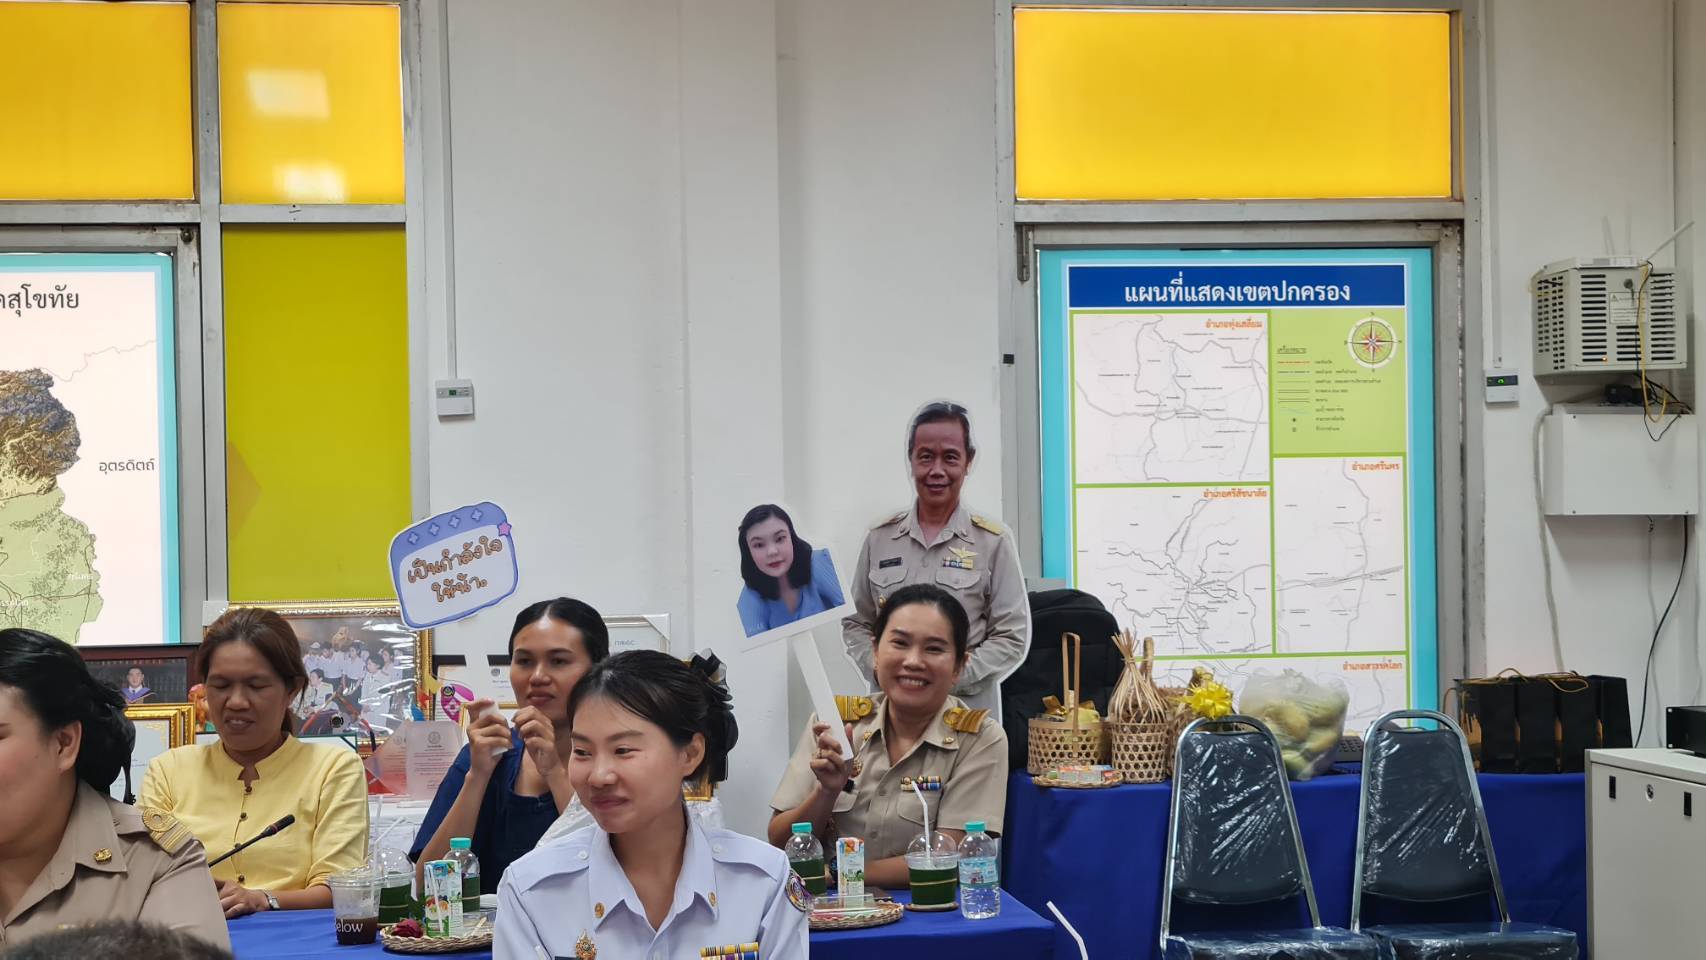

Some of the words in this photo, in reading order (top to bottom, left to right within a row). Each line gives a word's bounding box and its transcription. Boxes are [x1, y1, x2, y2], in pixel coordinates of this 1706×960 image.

[1124, 272, 1351, 302] แผนที่แสดงเขตปกครอง
[99, 458, 155, 475] อุตรดิตถ์
[407, 535, 502, 584] เป็นกำลังใจ
